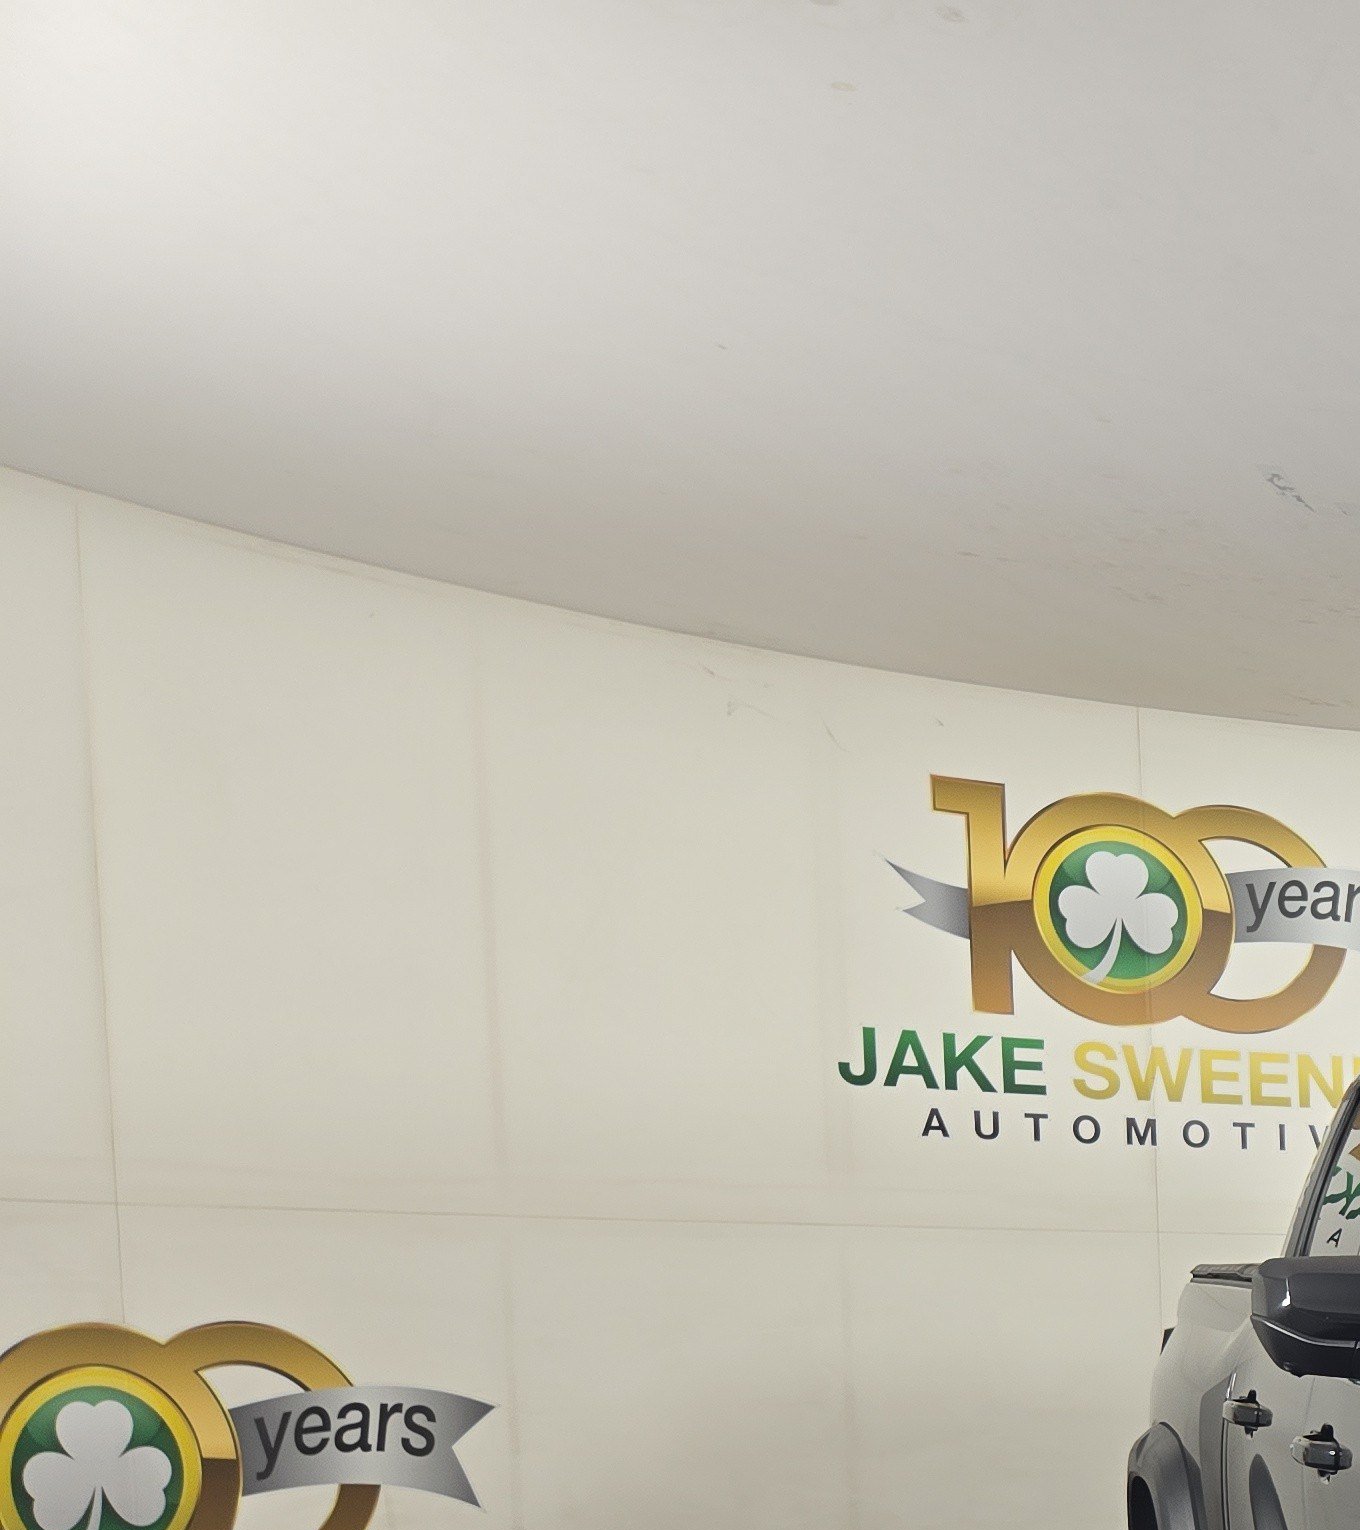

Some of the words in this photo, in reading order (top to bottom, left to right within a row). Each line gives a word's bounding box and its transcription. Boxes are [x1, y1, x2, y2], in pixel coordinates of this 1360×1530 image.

[837, 1026, 1048, 1096] JAKE
[921, 1107, 1329, 1151] AUTOMOTIV
[255, 1401, 437, 1480] years
